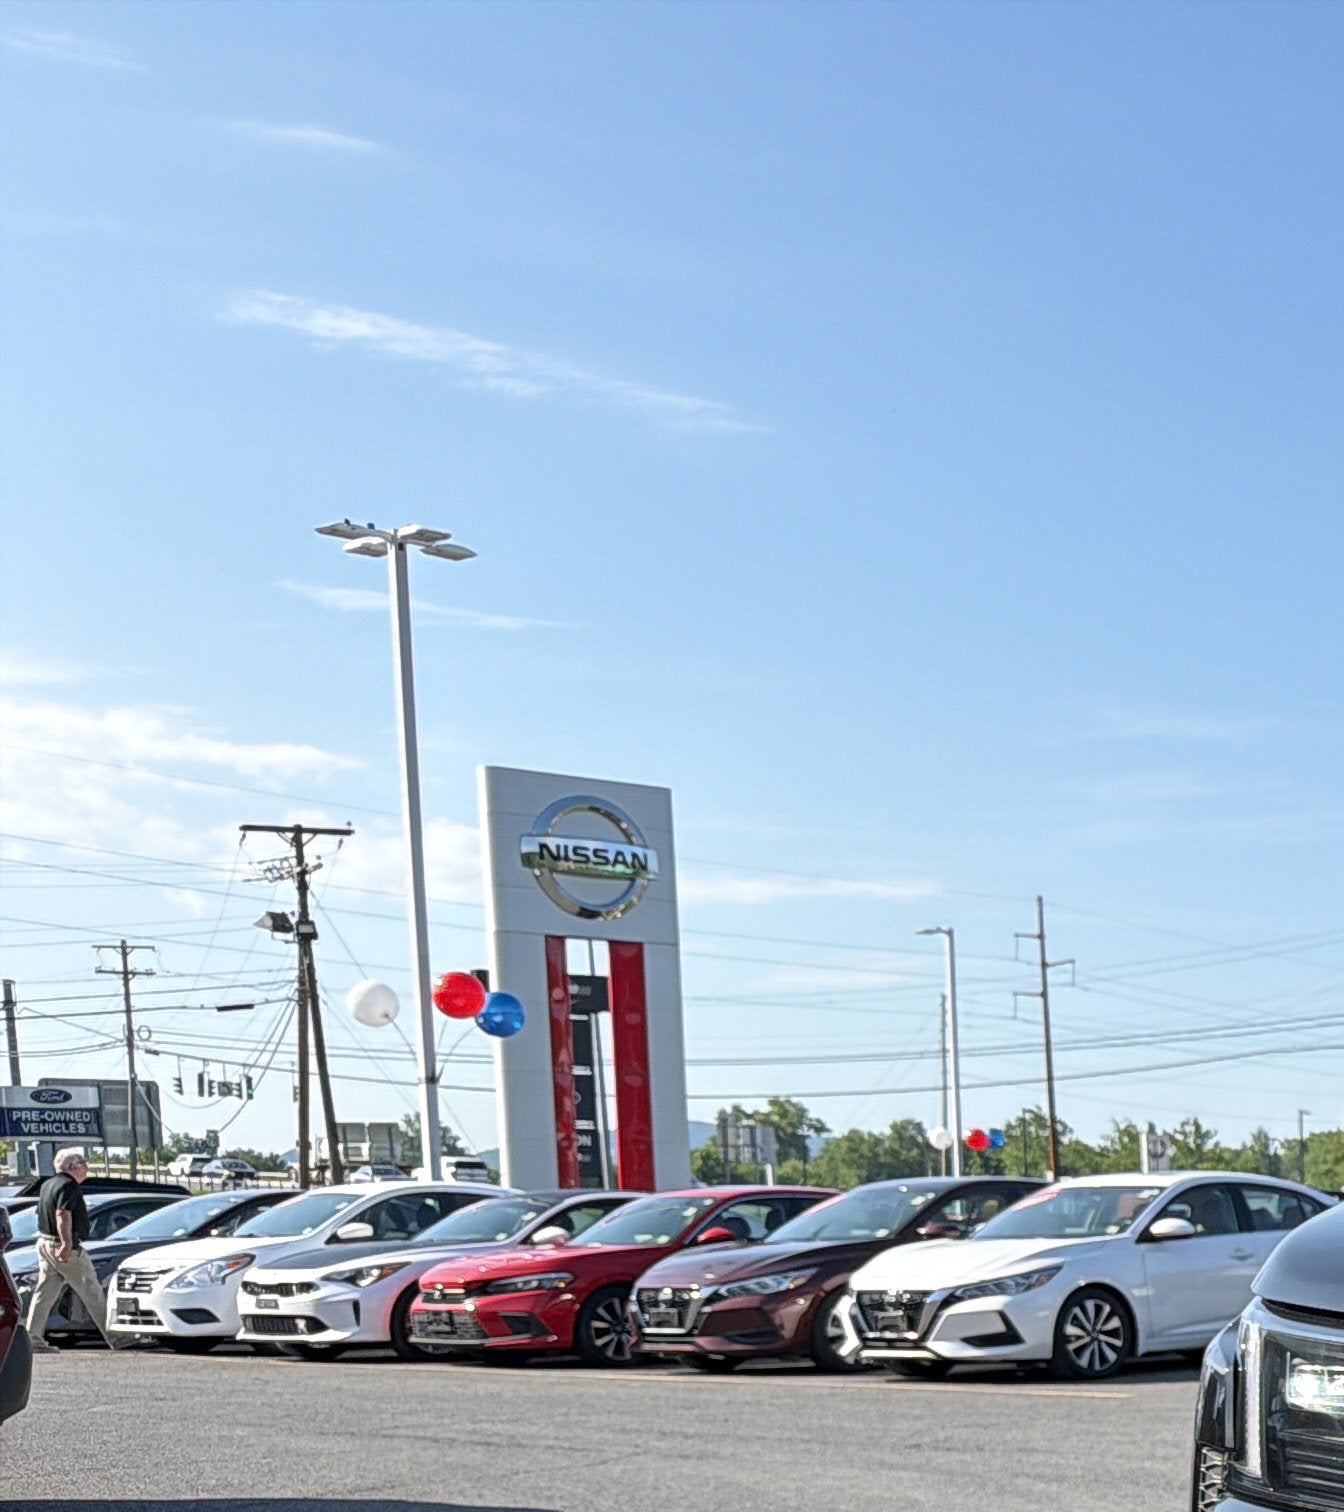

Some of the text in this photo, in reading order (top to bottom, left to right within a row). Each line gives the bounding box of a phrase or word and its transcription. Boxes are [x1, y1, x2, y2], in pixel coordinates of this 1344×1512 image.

[537, 843, 649, 871] NISSAN
[38, 1090, 67, 1102] Ford
[12, 1110, 91, 1122] PRE-OWNED
[21, 1122, 86, 1134] VEHICLES
